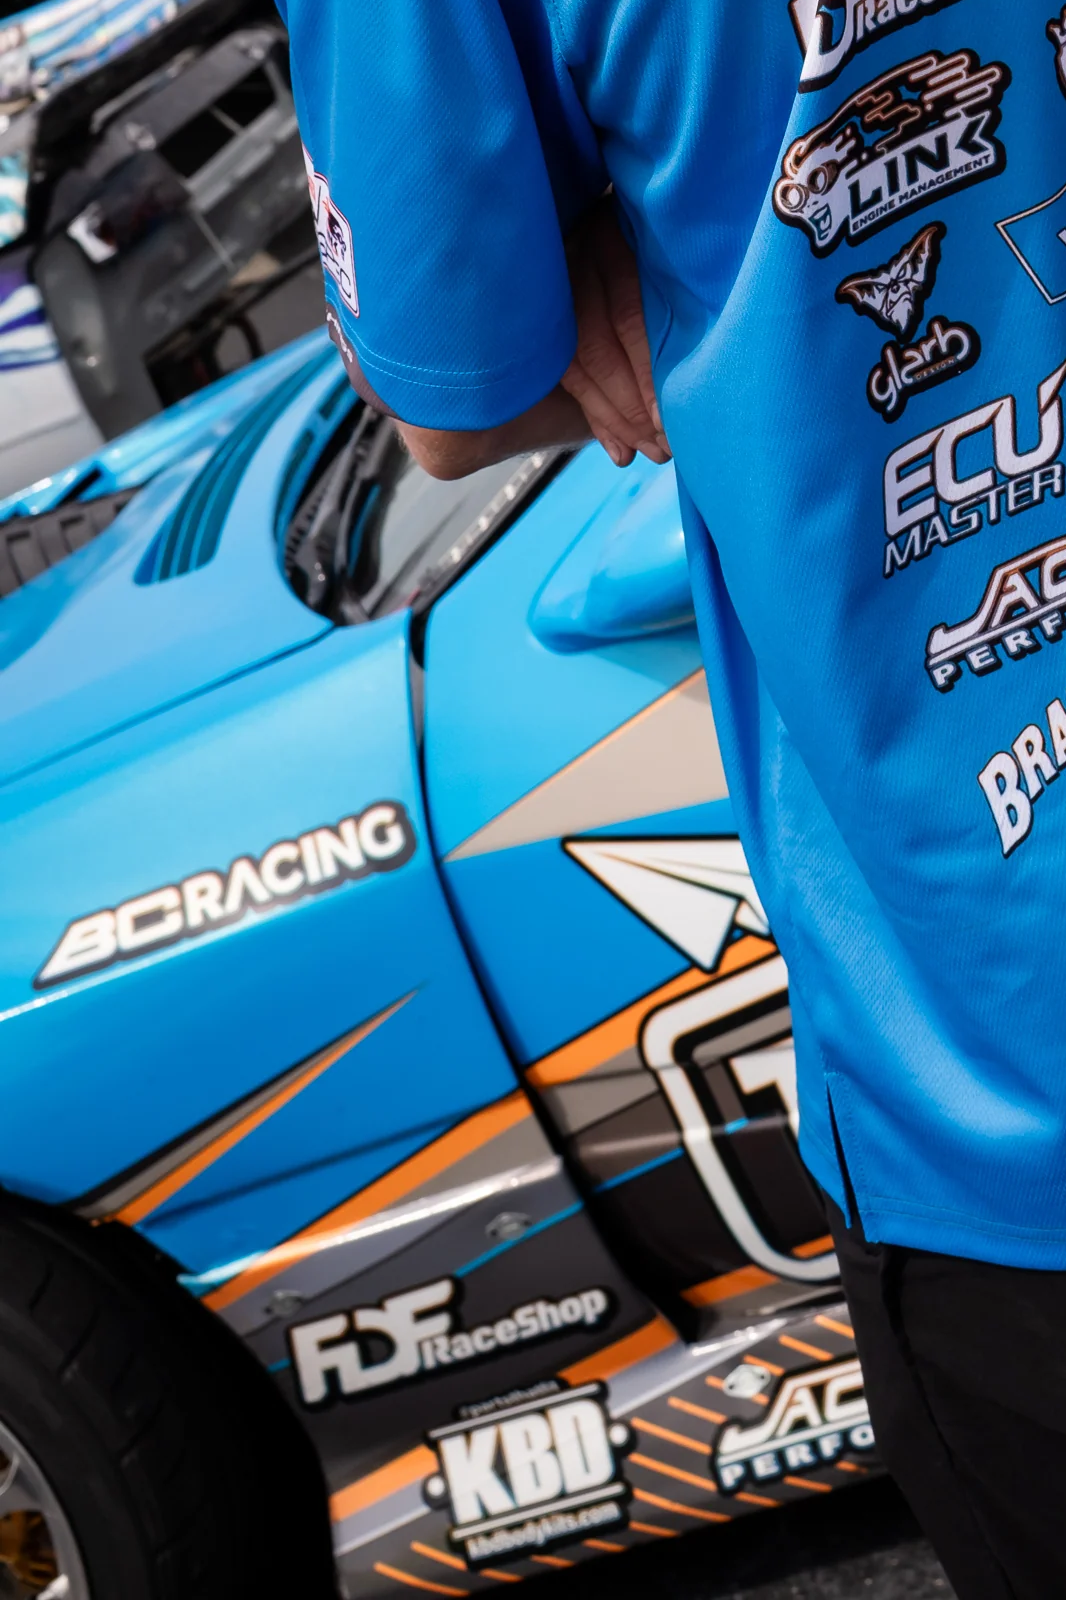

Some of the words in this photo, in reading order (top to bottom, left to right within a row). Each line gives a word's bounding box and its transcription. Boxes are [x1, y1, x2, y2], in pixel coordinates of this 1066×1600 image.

[848, 115, 987, 219] LINK
[851, 198, 897, 233] ENGINE
[897, 153, 992, 204] MANAGEMENT
[883, 462, 1064, 578] MASTER
[418, 1288, 609, 1370] RaceShop
[438, 1399, 615, 1526] KBD
